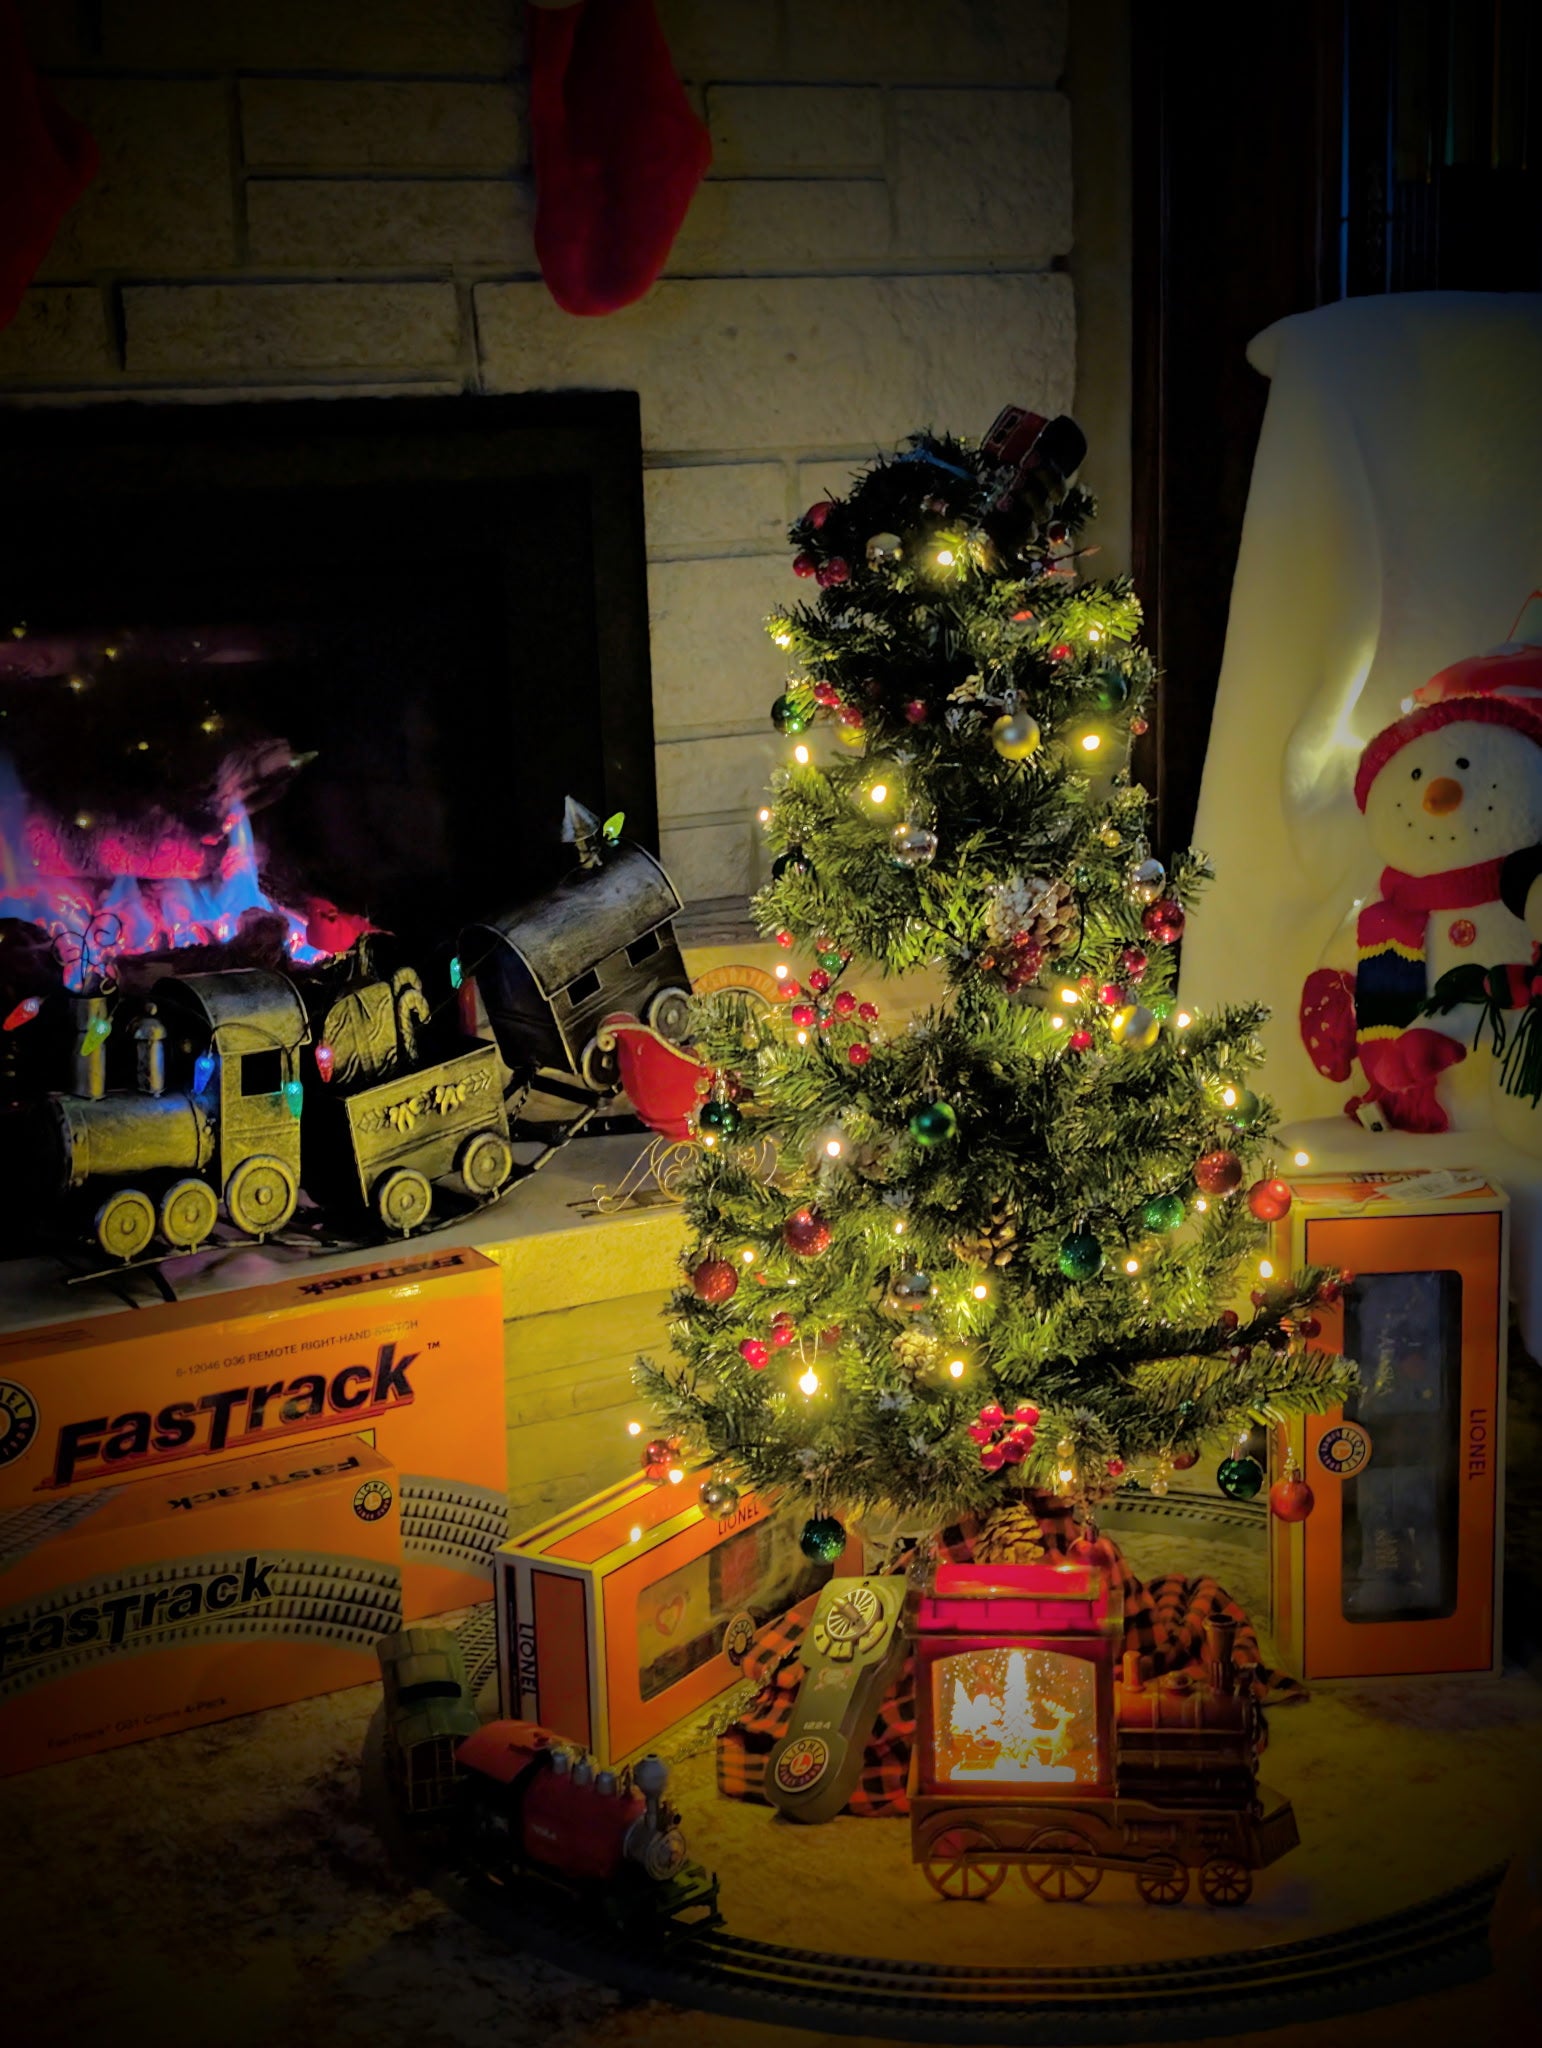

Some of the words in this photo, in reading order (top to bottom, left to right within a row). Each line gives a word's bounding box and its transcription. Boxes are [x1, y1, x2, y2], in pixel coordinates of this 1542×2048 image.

[248, 1344, 297, 1364] REMOTE
[301, 1328, 372, 1352] RIGHT-HAND
[1469, 1409, 1487, 1480] LIONEL
[718, 1502, 759, 1536] LIONEL
[519, 1623, 537, 1696] LIONEL
